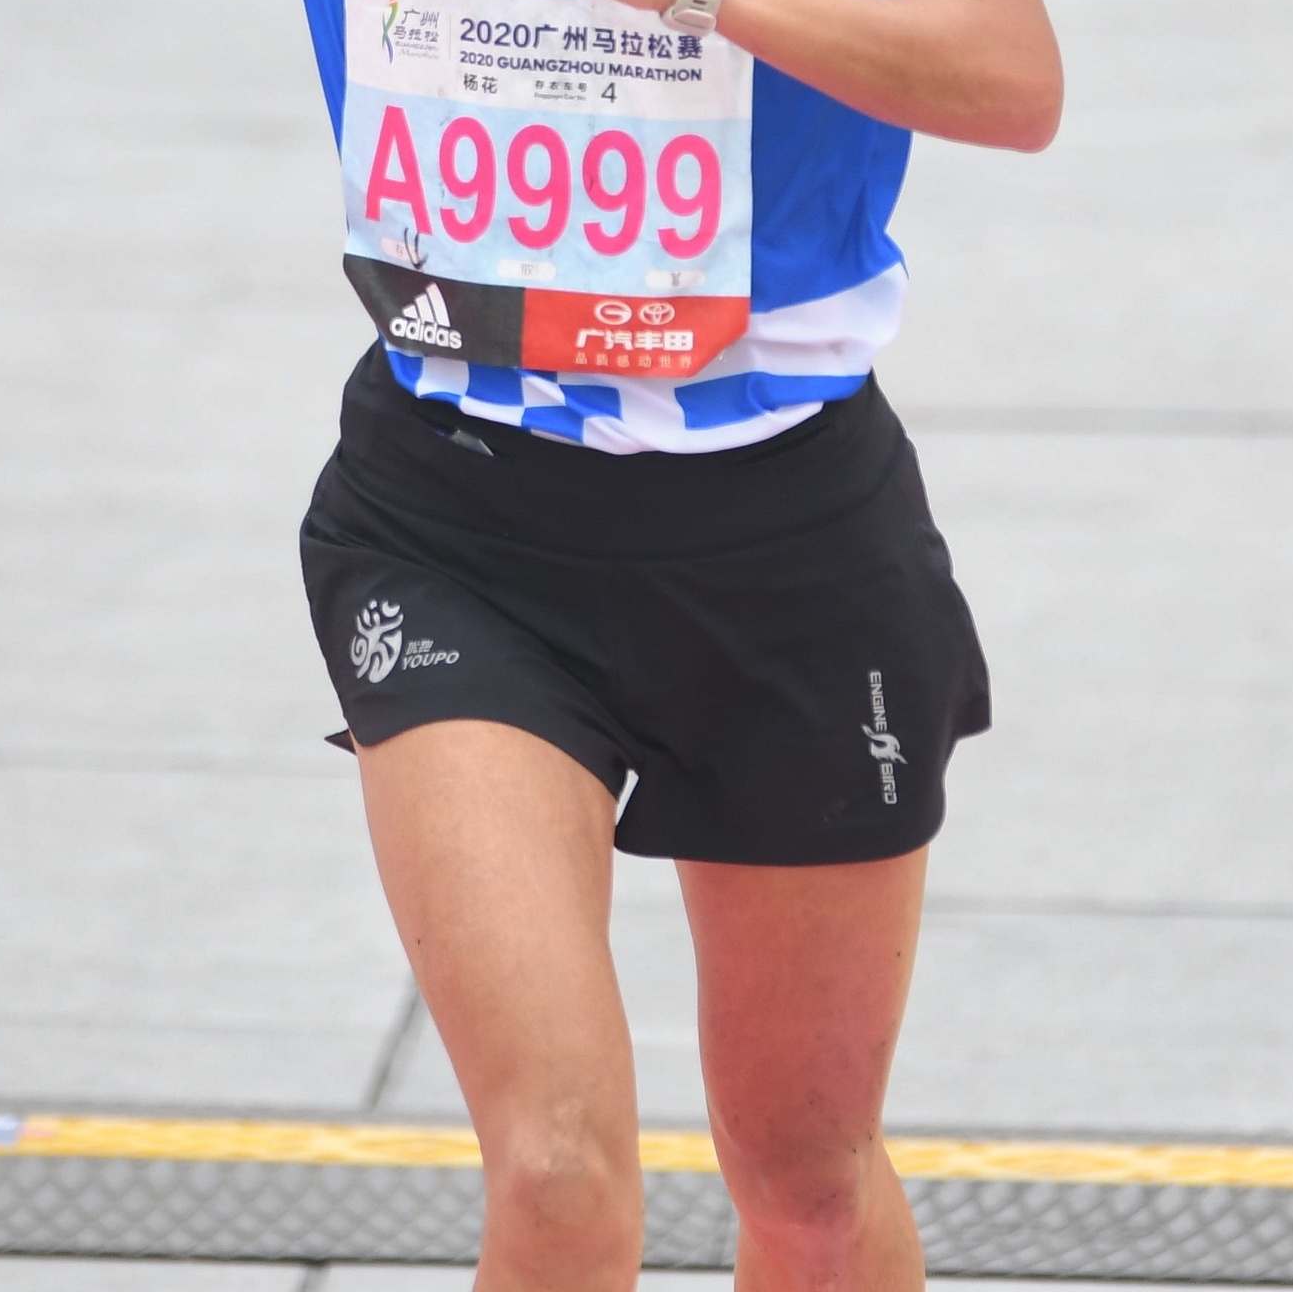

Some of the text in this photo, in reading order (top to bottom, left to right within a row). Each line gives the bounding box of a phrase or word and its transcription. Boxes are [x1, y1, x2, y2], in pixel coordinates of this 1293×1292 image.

[460, 17, 703, 60] 2020广州马拉松赛
[460, 51, 702, 82] 2020 GUANGZHOU MARATHON
[463, 73, 498, 95] 杨花
[601, 82, 617, 104] 4
[365, 105, 722, 260] A9999
[389, 317, 463, 350] adidas
[575, 328, 694, 351] 广汽丰田
[403, 651, 460, 670] YOUPO
[869, 670, 888, 732] ENGINE
[880, 762, 898, 805] BIRD
